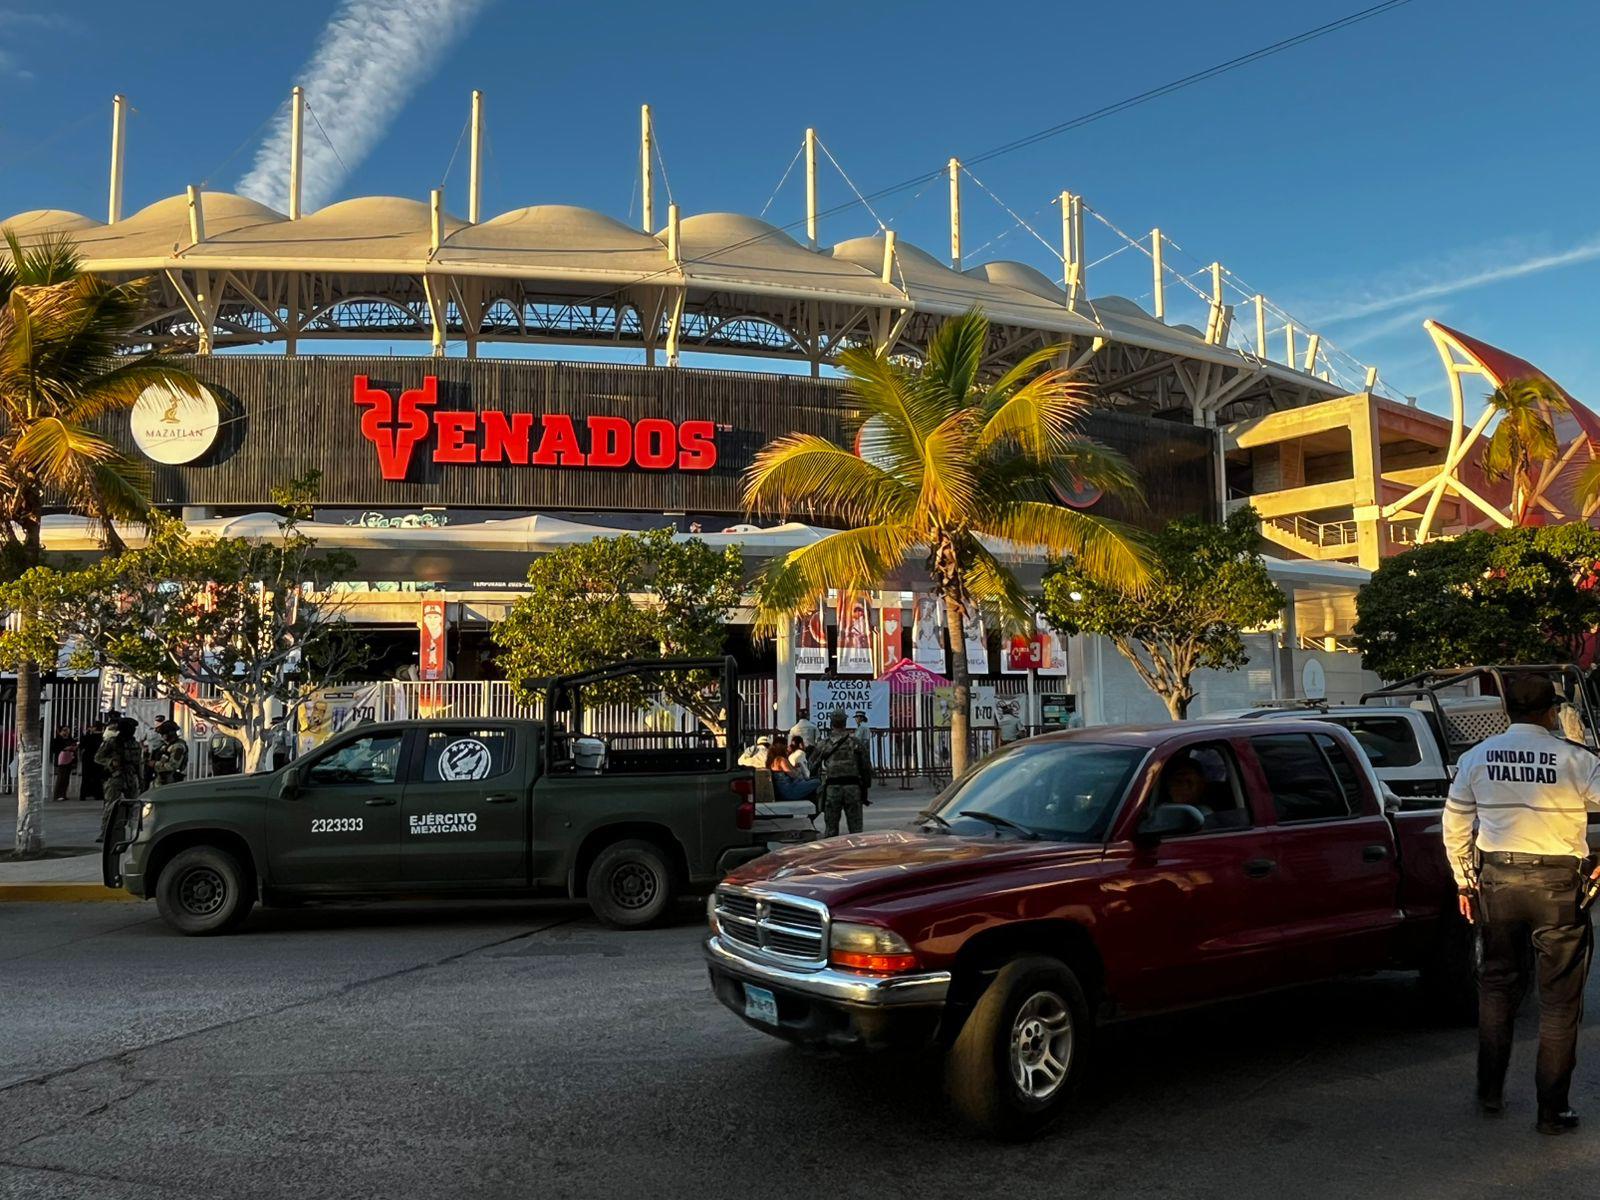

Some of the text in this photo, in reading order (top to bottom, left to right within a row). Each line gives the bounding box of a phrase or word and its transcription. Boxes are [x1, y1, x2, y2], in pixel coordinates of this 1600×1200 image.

[1030, 642, 1041, 662] 3
[827, 681, 872, 690] ACCESO A
[831, 690, 870, 701] ZONAS
[1486, 750, 1557, 766] UNIDAD DE
[1487, 765, 1557, 784] VIALIDAD
[311, 817, 364, 833] 2323333
[409, 812, 478, 826] EJÉRCITO
[410, 823, 478, 835] MEXICANO
